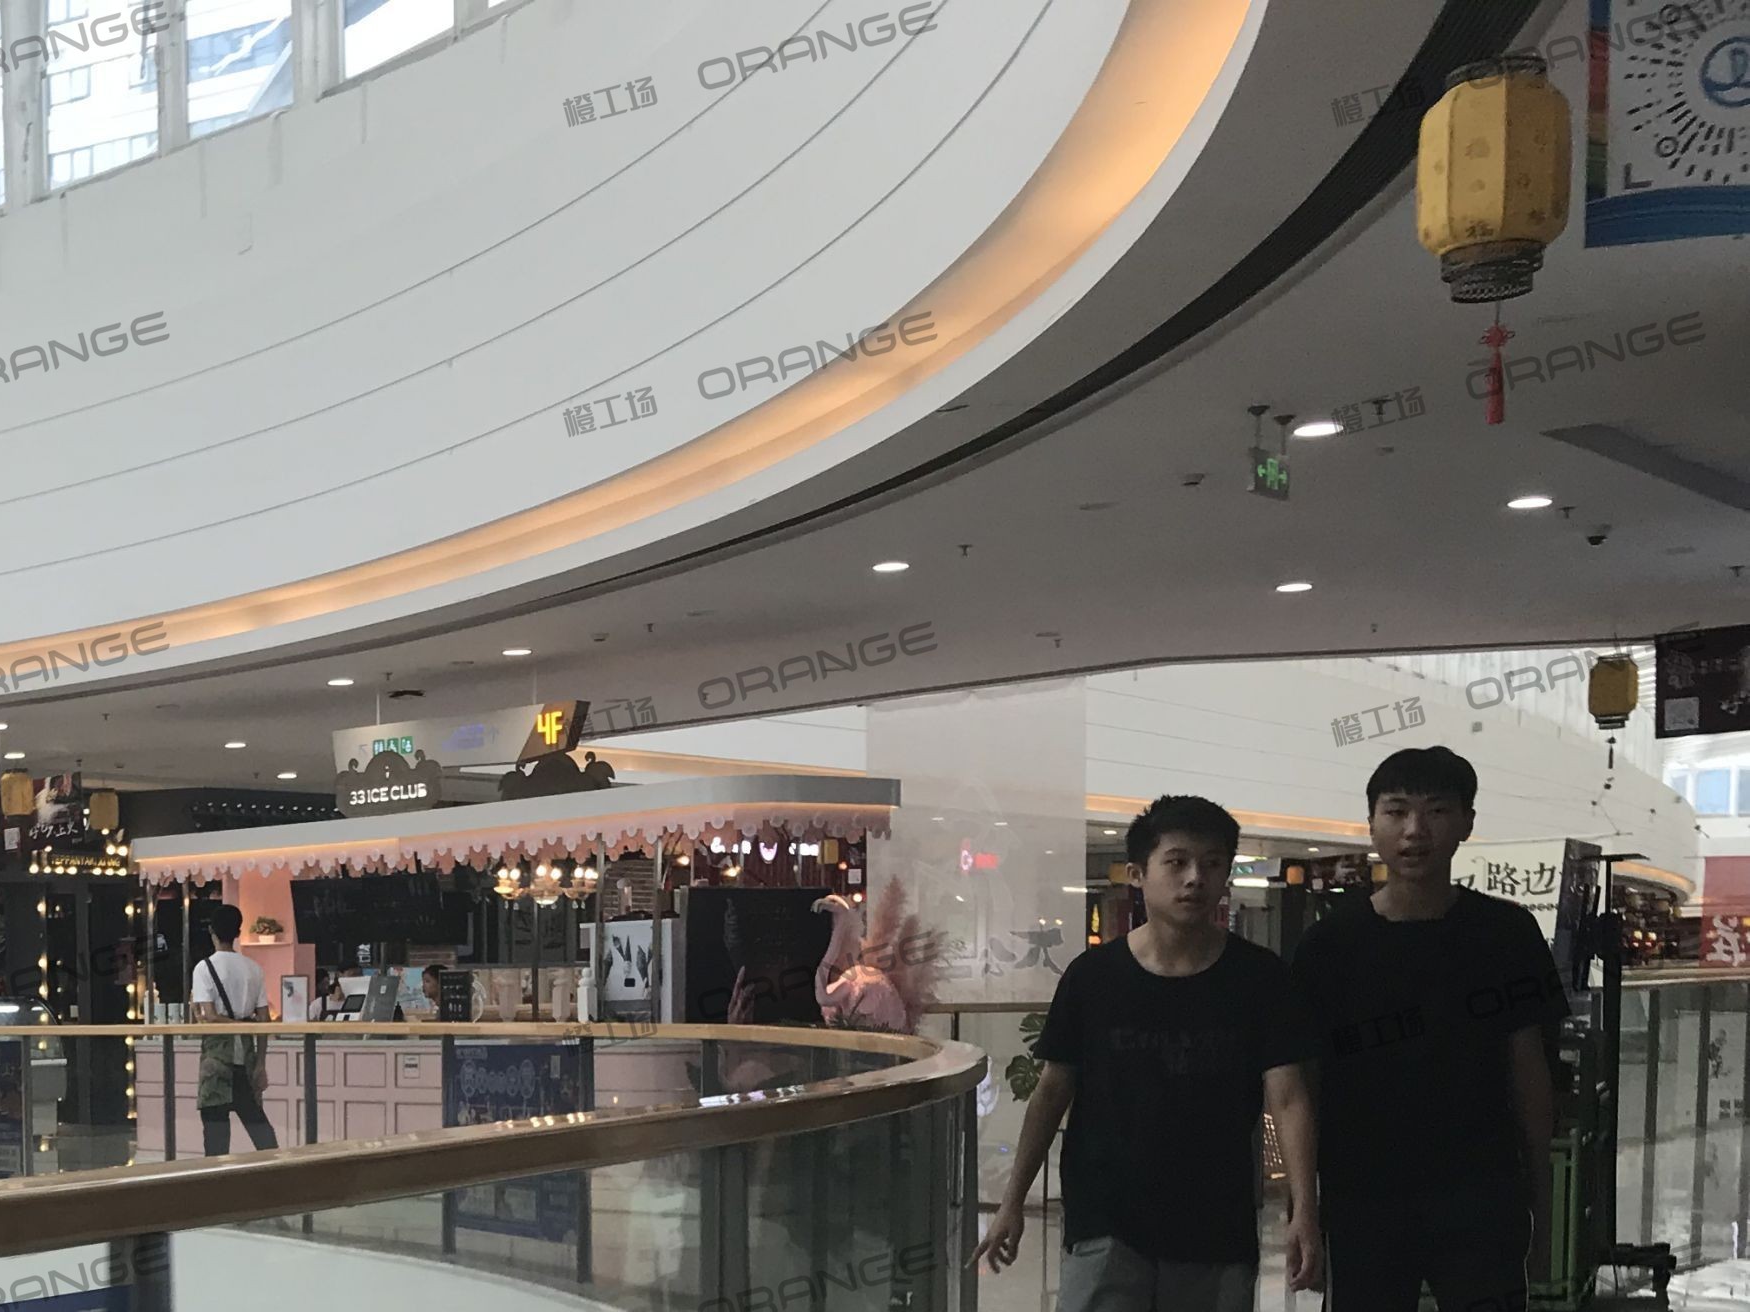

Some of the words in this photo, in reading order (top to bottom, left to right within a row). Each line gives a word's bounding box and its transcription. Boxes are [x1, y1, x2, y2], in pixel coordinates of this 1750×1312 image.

[537, 711, 563, 745] 4F
[350, 791, 365, 805] 33
[367, 787, 388, 803] ICE
[390, 783, 427, 800] CLUB
